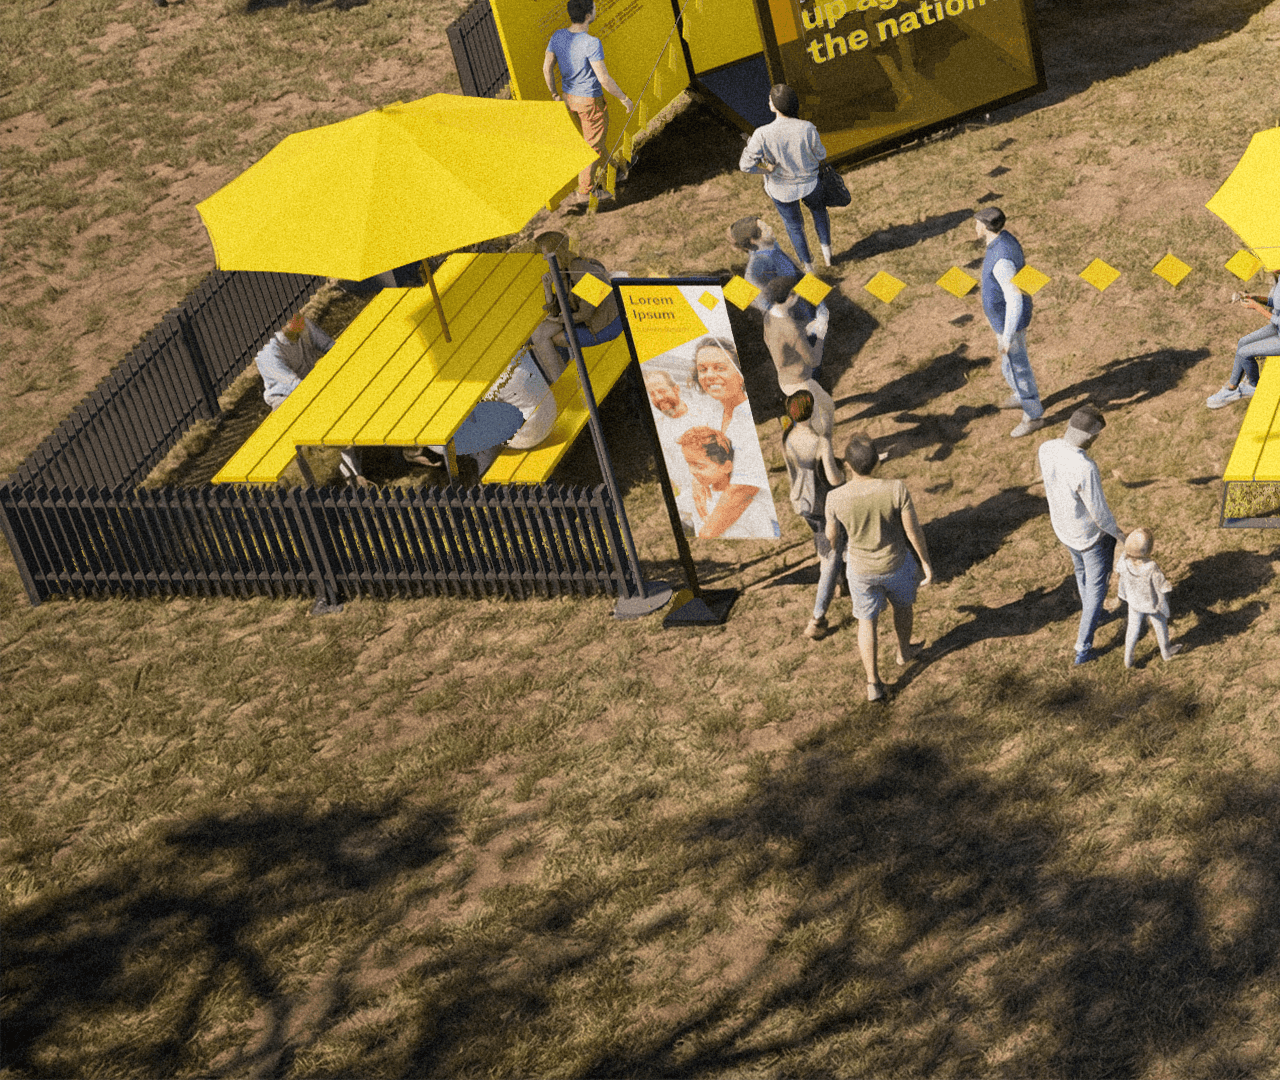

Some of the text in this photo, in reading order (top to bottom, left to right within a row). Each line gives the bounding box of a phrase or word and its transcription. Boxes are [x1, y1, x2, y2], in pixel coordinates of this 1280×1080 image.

[801, 0, 847, 31] up
[807, 28, 869, 64] the
[629, 294, 674, 306] Lorem
[632, 309, 675, 322] Ipsum
